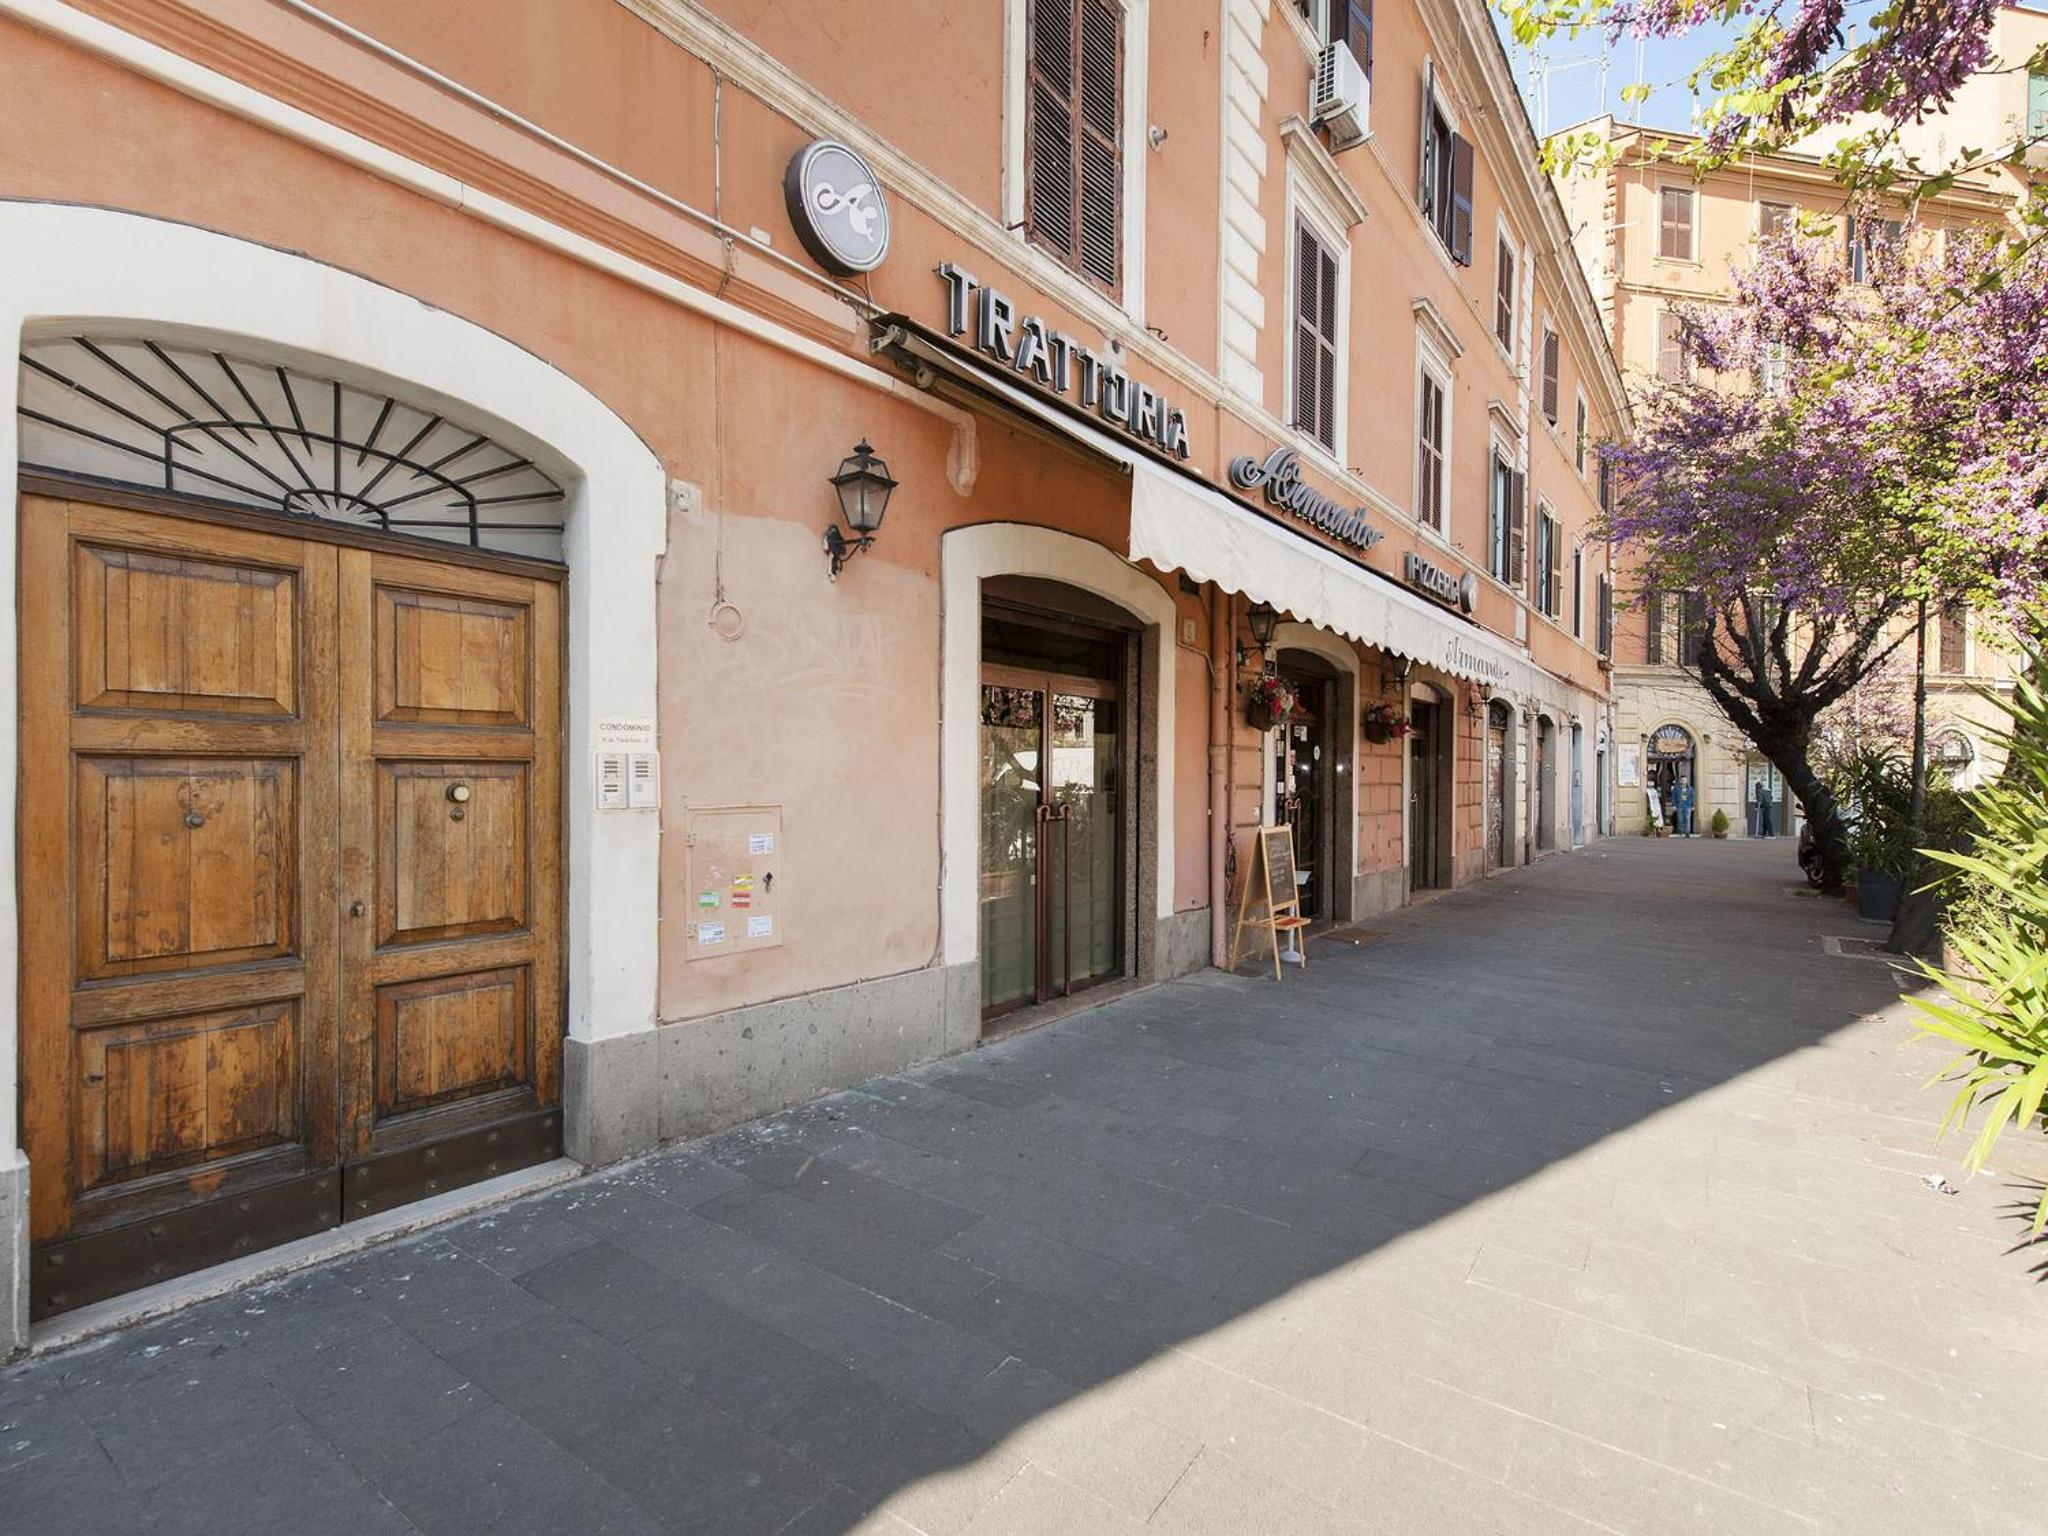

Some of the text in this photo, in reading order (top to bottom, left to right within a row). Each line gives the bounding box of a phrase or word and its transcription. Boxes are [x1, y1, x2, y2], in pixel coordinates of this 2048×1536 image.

[938, 261, 1461, 605] TRATTORIA Armando PIZZERIA
[600, 722, 652, 733] CONDOMINIO
